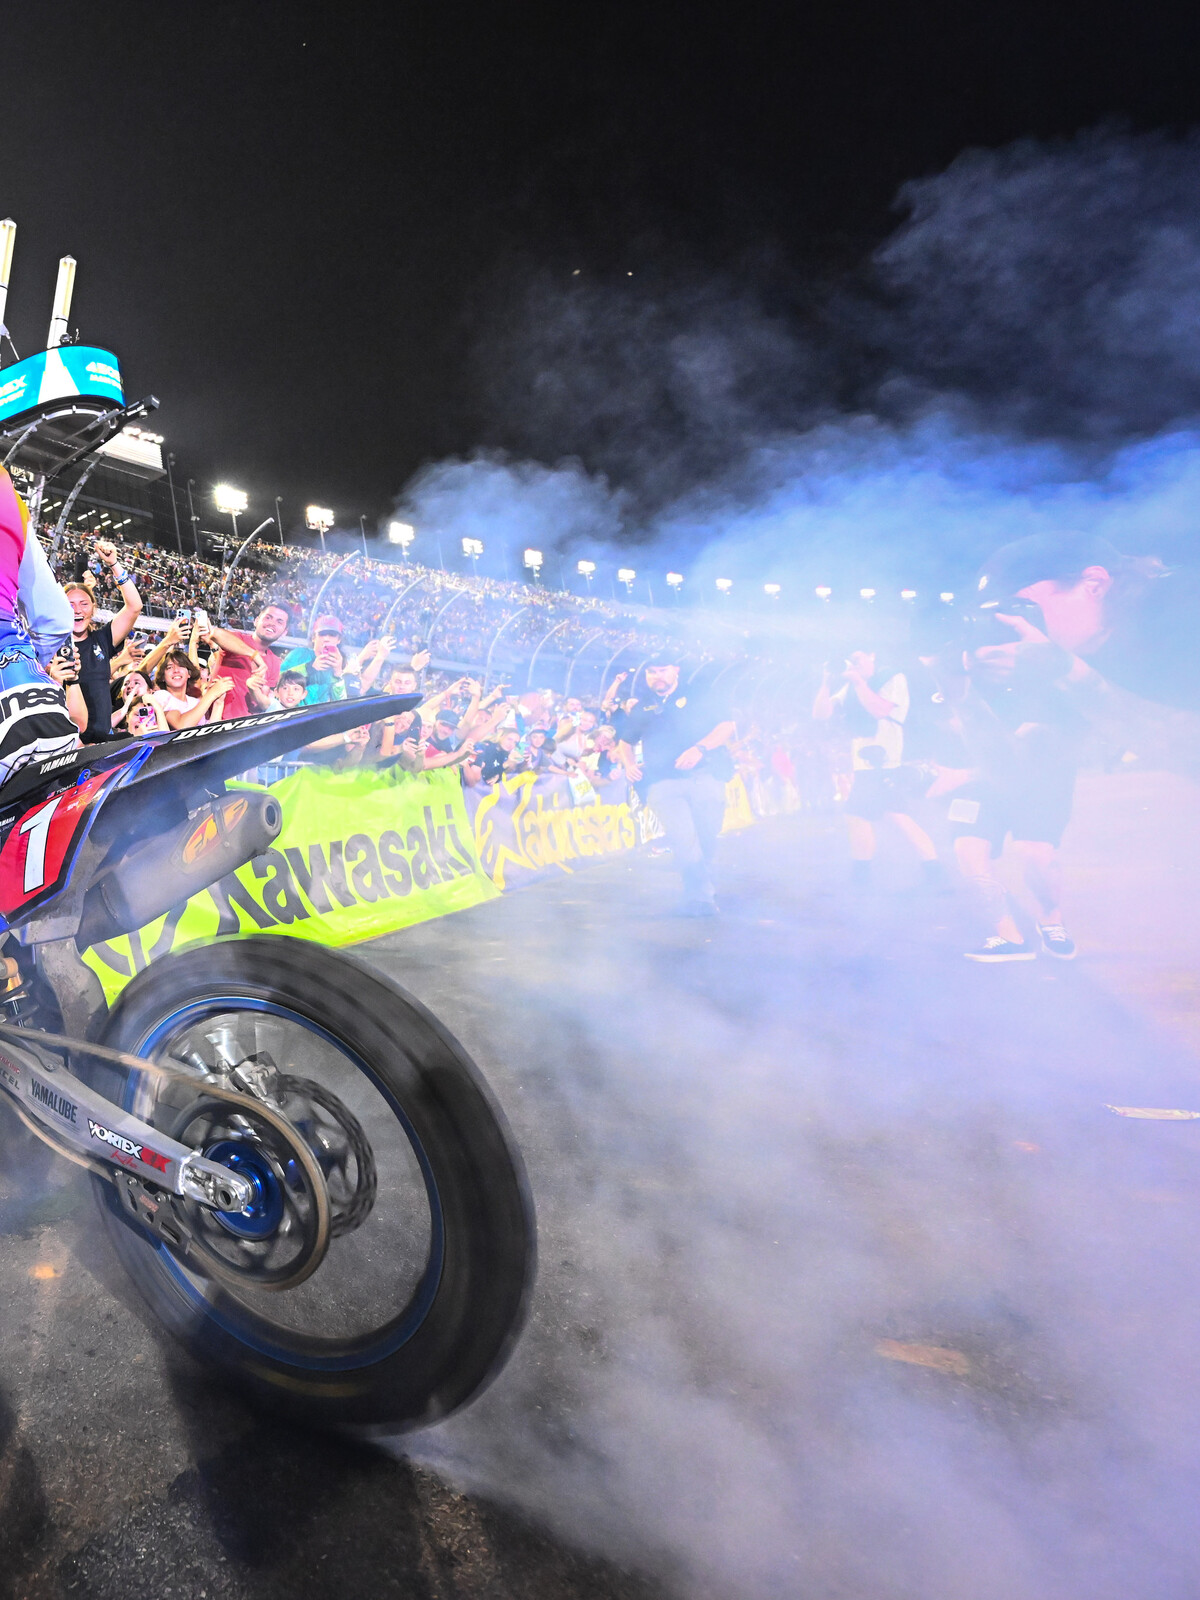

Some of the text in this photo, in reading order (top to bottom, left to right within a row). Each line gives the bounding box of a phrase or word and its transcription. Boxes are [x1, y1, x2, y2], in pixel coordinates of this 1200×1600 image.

[172, 709, 309, 742] DUNLOP
[39, 752, 79, 774] YAMAHA
[20, 795, 64, 894] 1
[208, 804, 475, 936] Kawasaki
[31, 1078, 78, 1123] YAMALUBE
[87, 1118, 143, 1159] VORTEX
